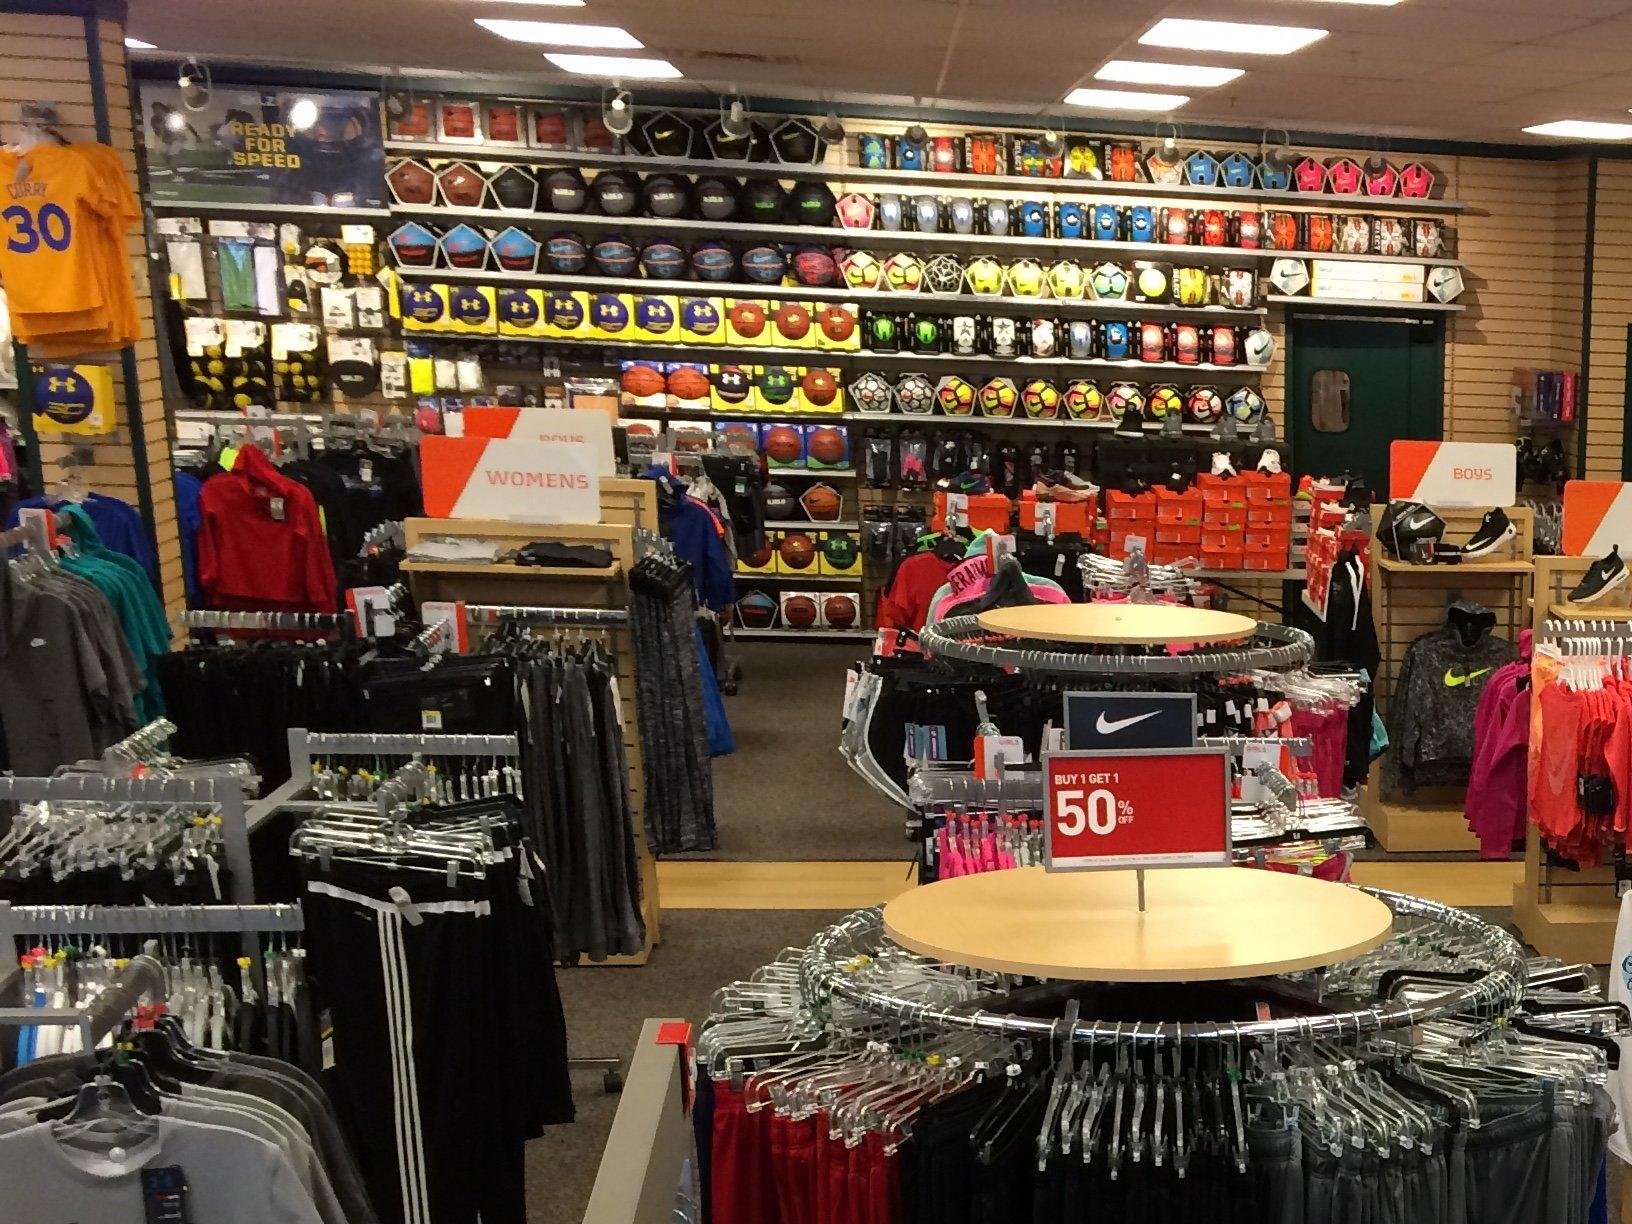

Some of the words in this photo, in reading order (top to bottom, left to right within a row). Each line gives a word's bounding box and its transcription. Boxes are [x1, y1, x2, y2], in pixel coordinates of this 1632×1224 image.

[229, 121, 297, 138] READY
[245, 137, 286, 152] FOR
[232, 151, 301, 169] SPEED
[2, 203, 71, 253] 30
[485, 470, 589, 489] WOMENS
[1453, 468, 1493, 481] BOYS
[1055, 774, 1078, 785] BUY
[1080, 774, 1086, 785] 1
[1088, 773, 1111, 784] GET
[1113, 773, 1119, 783] 1
[1118, 815, 1134, 825] OFF
